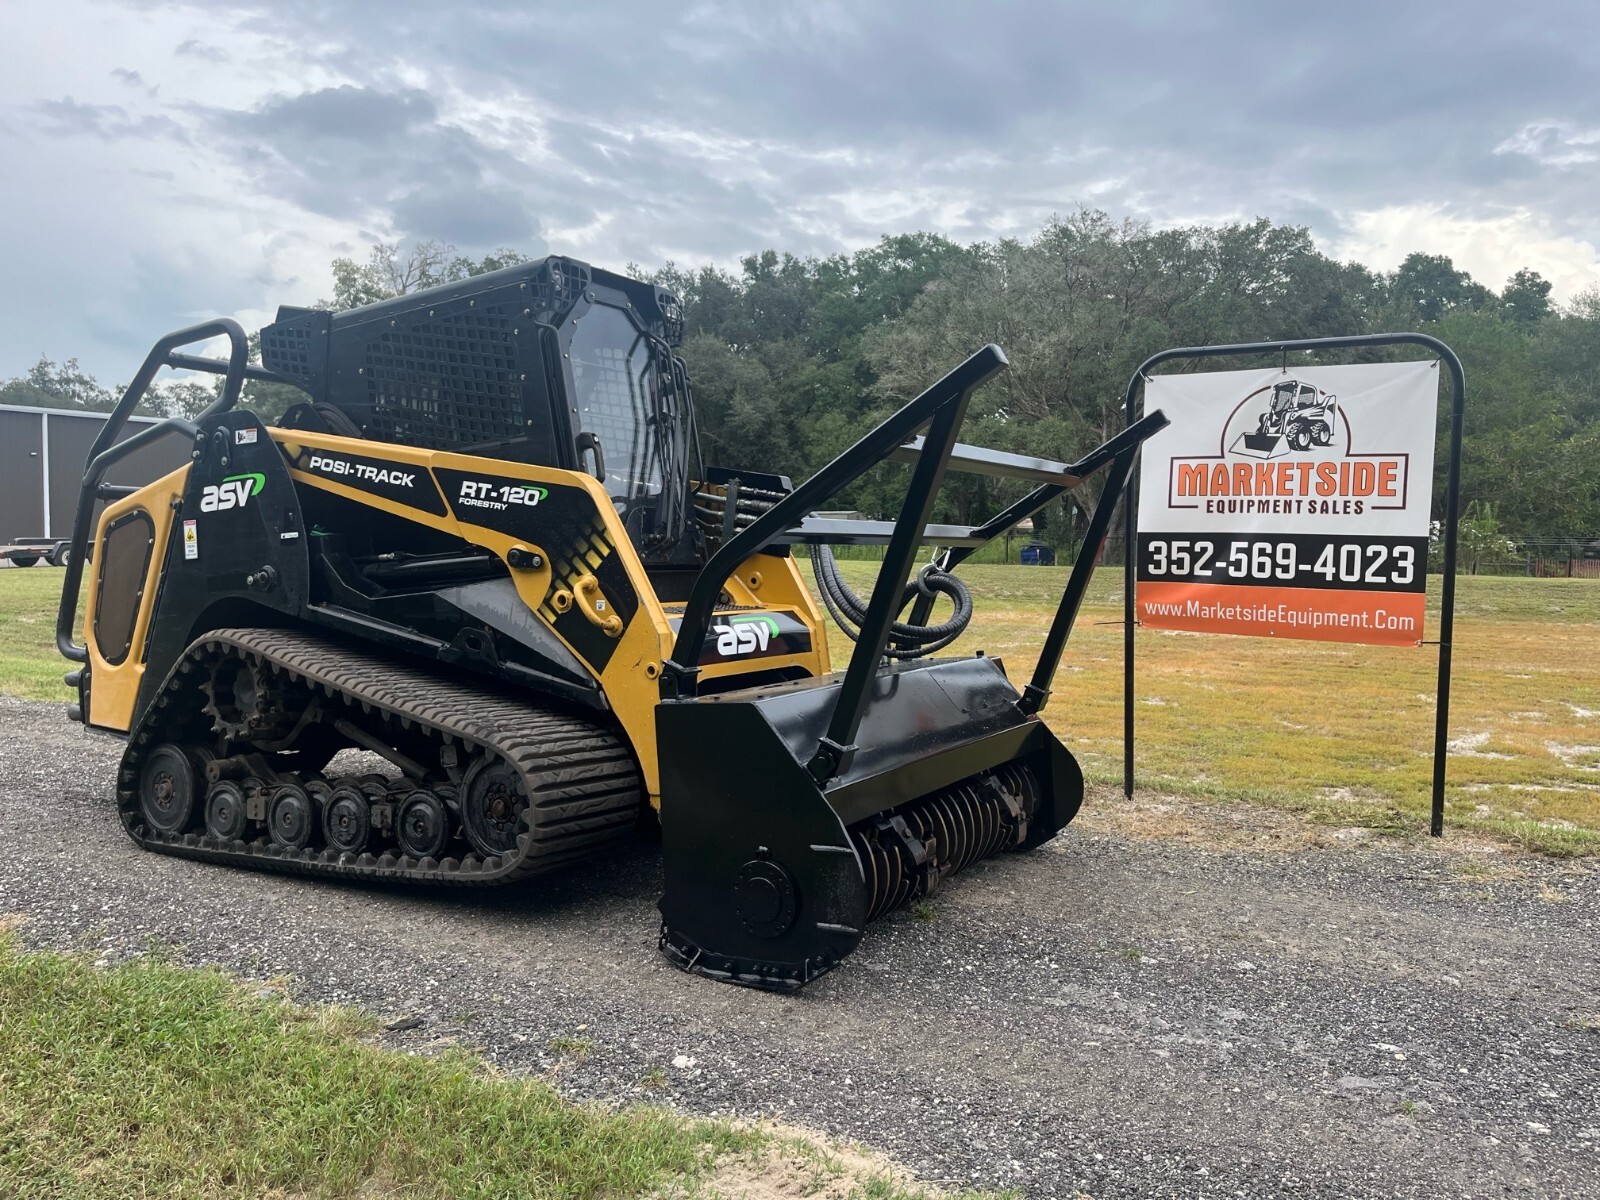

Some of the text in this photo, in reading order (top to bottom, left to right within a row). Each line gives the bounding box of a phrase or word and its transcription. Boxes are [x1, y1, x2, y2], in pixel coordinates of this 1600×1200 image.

[309, 456, 415, 488] POSI-TRACK
[1177, 461, 1398, 497] MARKETSIDE
[458, 497, 509, 511] FORESTRY
[460, 480, 541, 506] RT-120
[1206, 499, 1364, 515] EQUIPMENT SALES
[1148, 540, 1415, 584] 352-569-4023
[1144, 600, 1415, 631] www.MarketsideEquipment.Com
